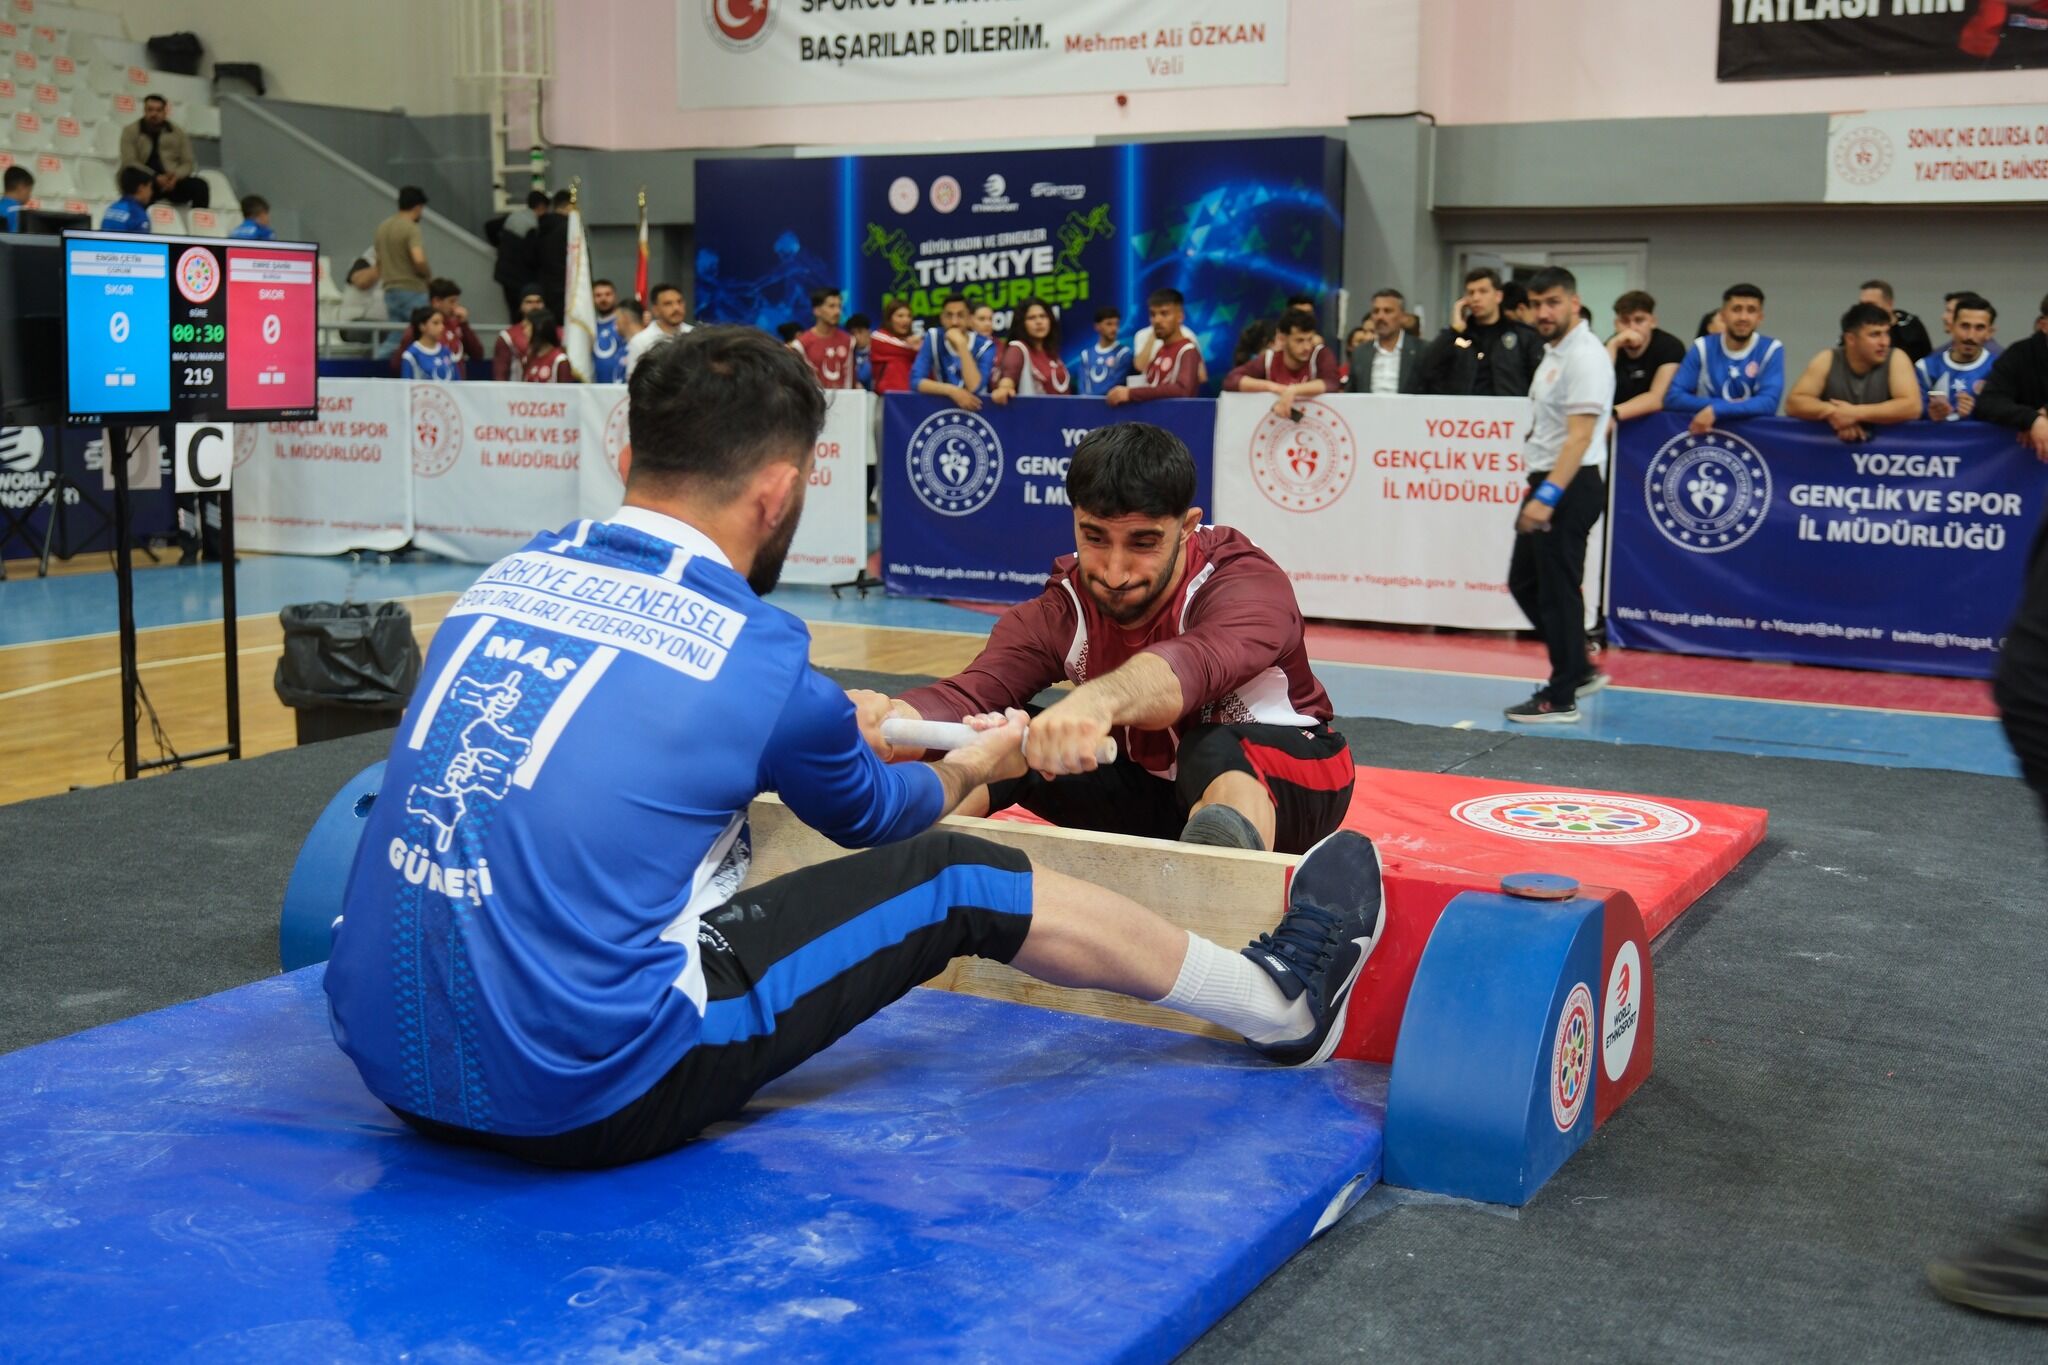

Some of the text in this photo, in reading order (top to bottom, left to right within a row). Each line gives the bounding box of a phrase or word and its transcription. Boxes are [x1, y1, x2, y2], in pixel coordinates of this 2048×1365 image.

[800, 30, 937, 67] BAŞARILAR
[944, 17, 1050, 54] DİLERİM.
[1064, 20, 1266, 53] Mehmet Ali ÖZKAN
[1145, 55, 1185, 76] Vali
[1906, 127, 1954, 152] SONUÇ
[1957, 127, 1975, 147] NE
[1977, 125, 2031, 147] OLURSA
[914, 244, 1054, 287] TÜRKİYE
[104, 283, 134, 296] SKOR
[258, 288, 286, 301] SKOR
[109, 311, 130, 343] 0
[172, 323, 225, 343] 00:30
[262, 313, 281, 345] 0
[183, 367, 215, 386] 219
[319, 396, 354, 413] ZGAT
[508, 401, 567, 418] YOZGAT
[328, 422, 348, 437] VE
[350, 422, 388, 438] SPOR
[473, 424, 536, 446] GENÇLİK
[540, 428, 560, 444] VE
[1425, 418, 1516, 440] YOZGAT
[187, 426, 225, 488] C
[275, 441, 382, 463] İL MÜDÜRLÜĞÜ
[480, 450, 494, 467] İL
[1373, 448, 1468, 473] GENÇLİK
[1473, 450, 1500, 472] VE
[1016, 455, 1070, 481] GENÇ
[1851, 453, 1962, 479] YOZGAT
[1024, 481, 1043, 505] İL
[1383, 477, 1401, 500] İL
[1789, 483, 2023, 517] GENÇLİK VE SPOR
[1798, 513, 2007, 552] İL MÜDÜRLÜĞÜ
[571, 575, 729, 642] GELENEKSEL
[1616, 606, 1647, 620] Web:
[1649, 608, 1758, 630] Yozgat.gsb.com.tr
[489, 589, 572, 622] DALLARI
[566, 608, 716, 671] FEDERASYONU
[483, 636, 577, 681] MAS
[388, 837, 494, 906] GÜREŞİ
[1613, 1002, 1632, 1028] WORLD
[1605, 1010, 1637, 1049] ETHNOSPORT
